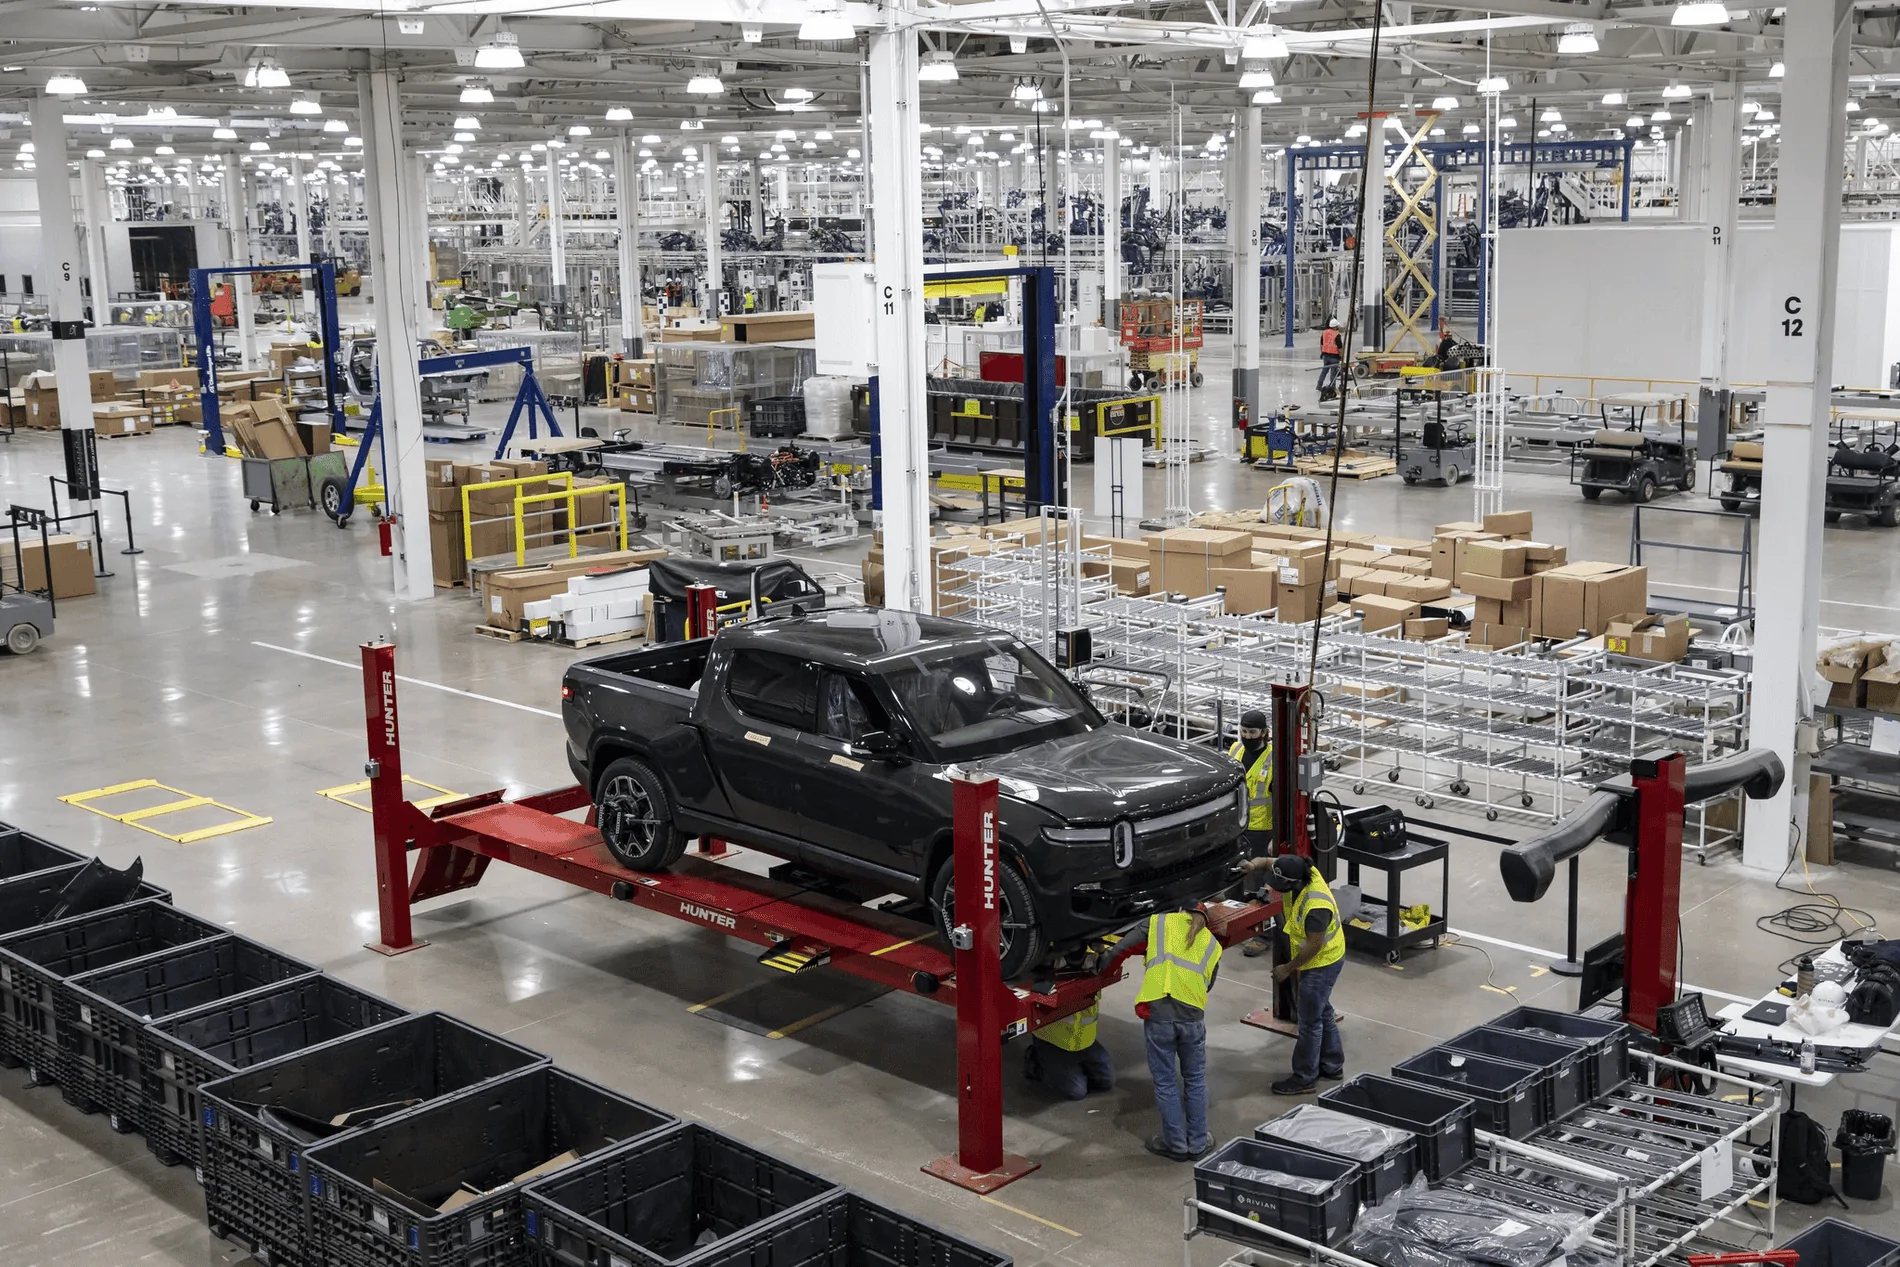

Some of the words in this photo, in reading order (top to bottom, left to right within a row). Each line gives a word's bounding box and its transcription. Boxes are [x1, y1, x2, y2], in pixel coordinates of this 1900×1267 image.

[1713, 226, 1721, 235] D
[1712, 236, 1721, 245] 11
[62, 262, 70, 271] C
[64, 272, 70, 281] 9
[883, 285, 893, 299] C
[883, 301, 894, 315] 11
[1784, 296, 1802, 315] C
[1781, 318, 1803, 337] 12
[382, 670, 396, 746] HUNTER
[983, 811, 995, 910] HUNTER
[680, 901, 736, 930] HUNTER
[1246, 1198, 1277, 1210] RIVIAN
